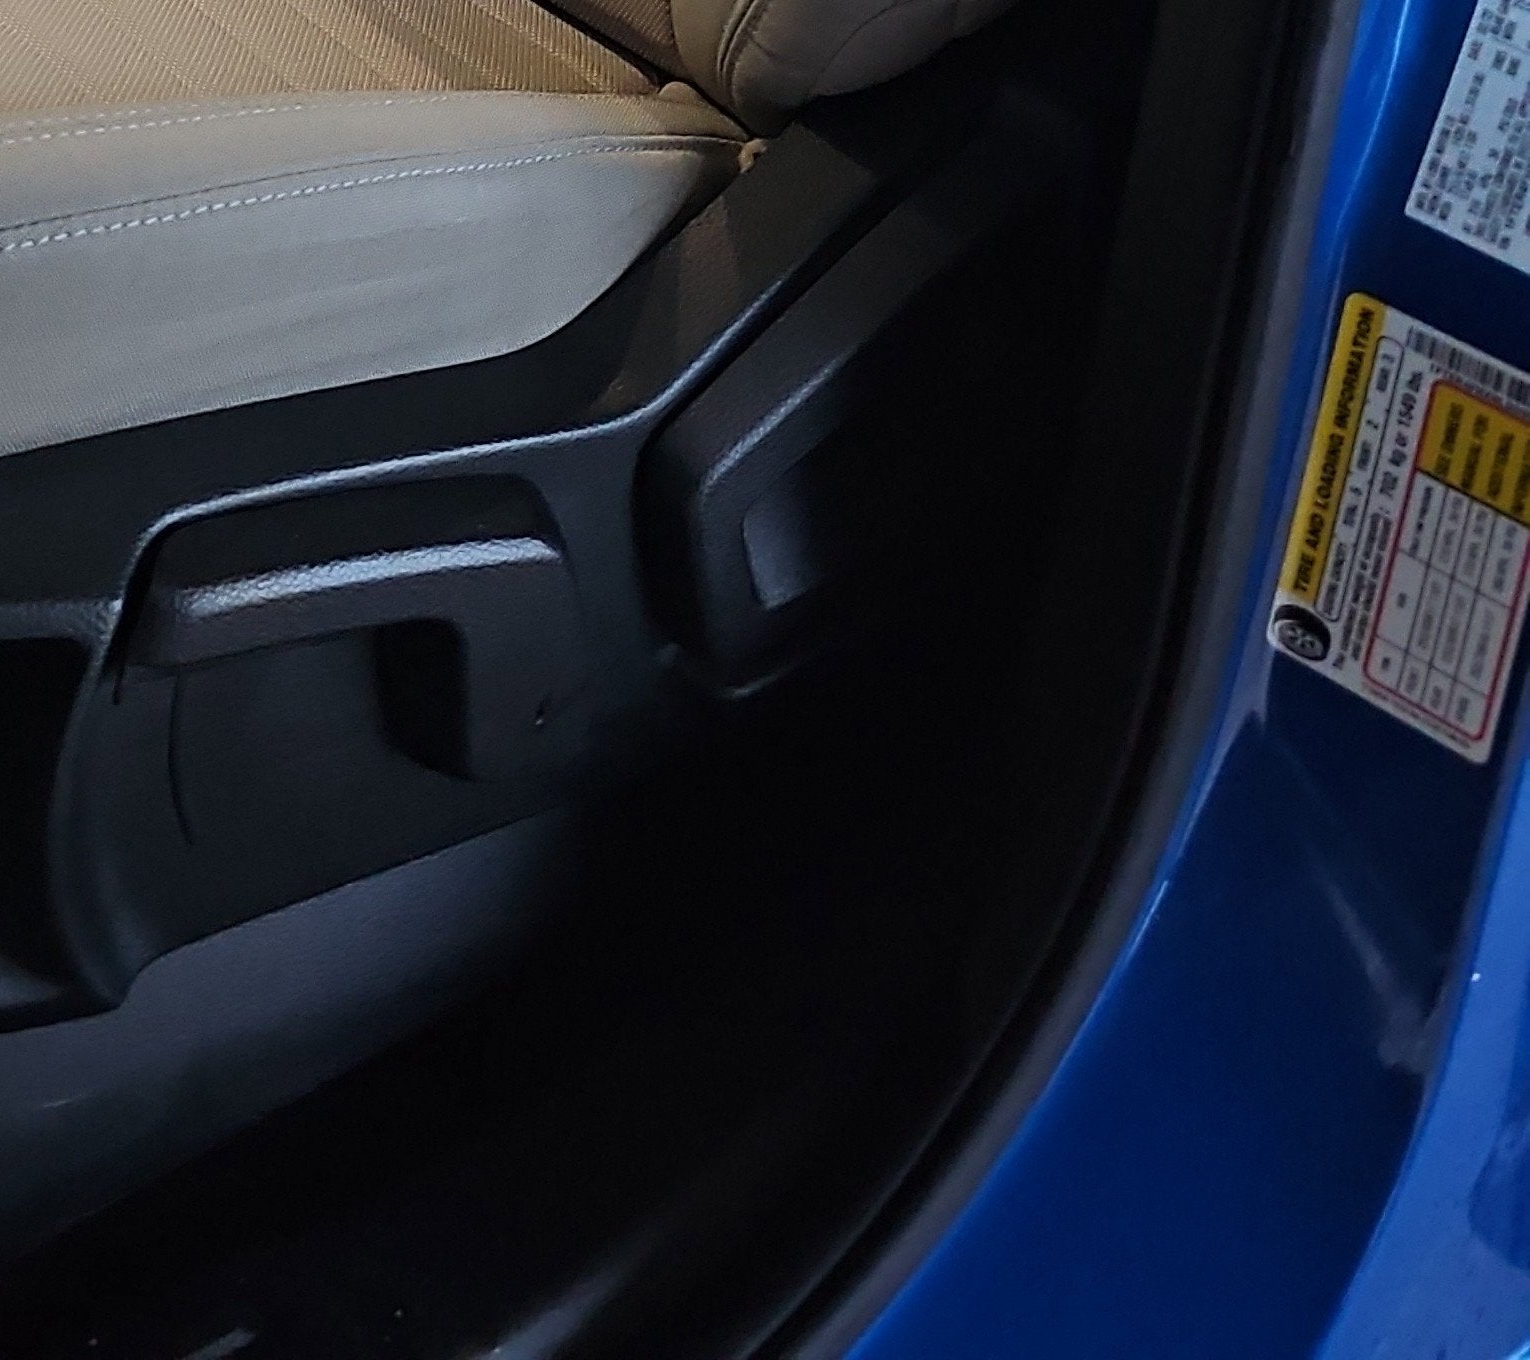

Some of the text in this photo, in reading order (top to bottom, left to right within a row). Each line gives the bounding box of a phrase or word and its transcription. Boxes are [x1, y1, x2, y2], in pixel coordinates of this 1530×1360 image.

[1293, 552, 1314, 592] TIRE
[1305, 511, 1324, 550] AND
[1315, 432, 1343, 510] LOADING
[1334, 307, 1375, 429] INFORMATION
